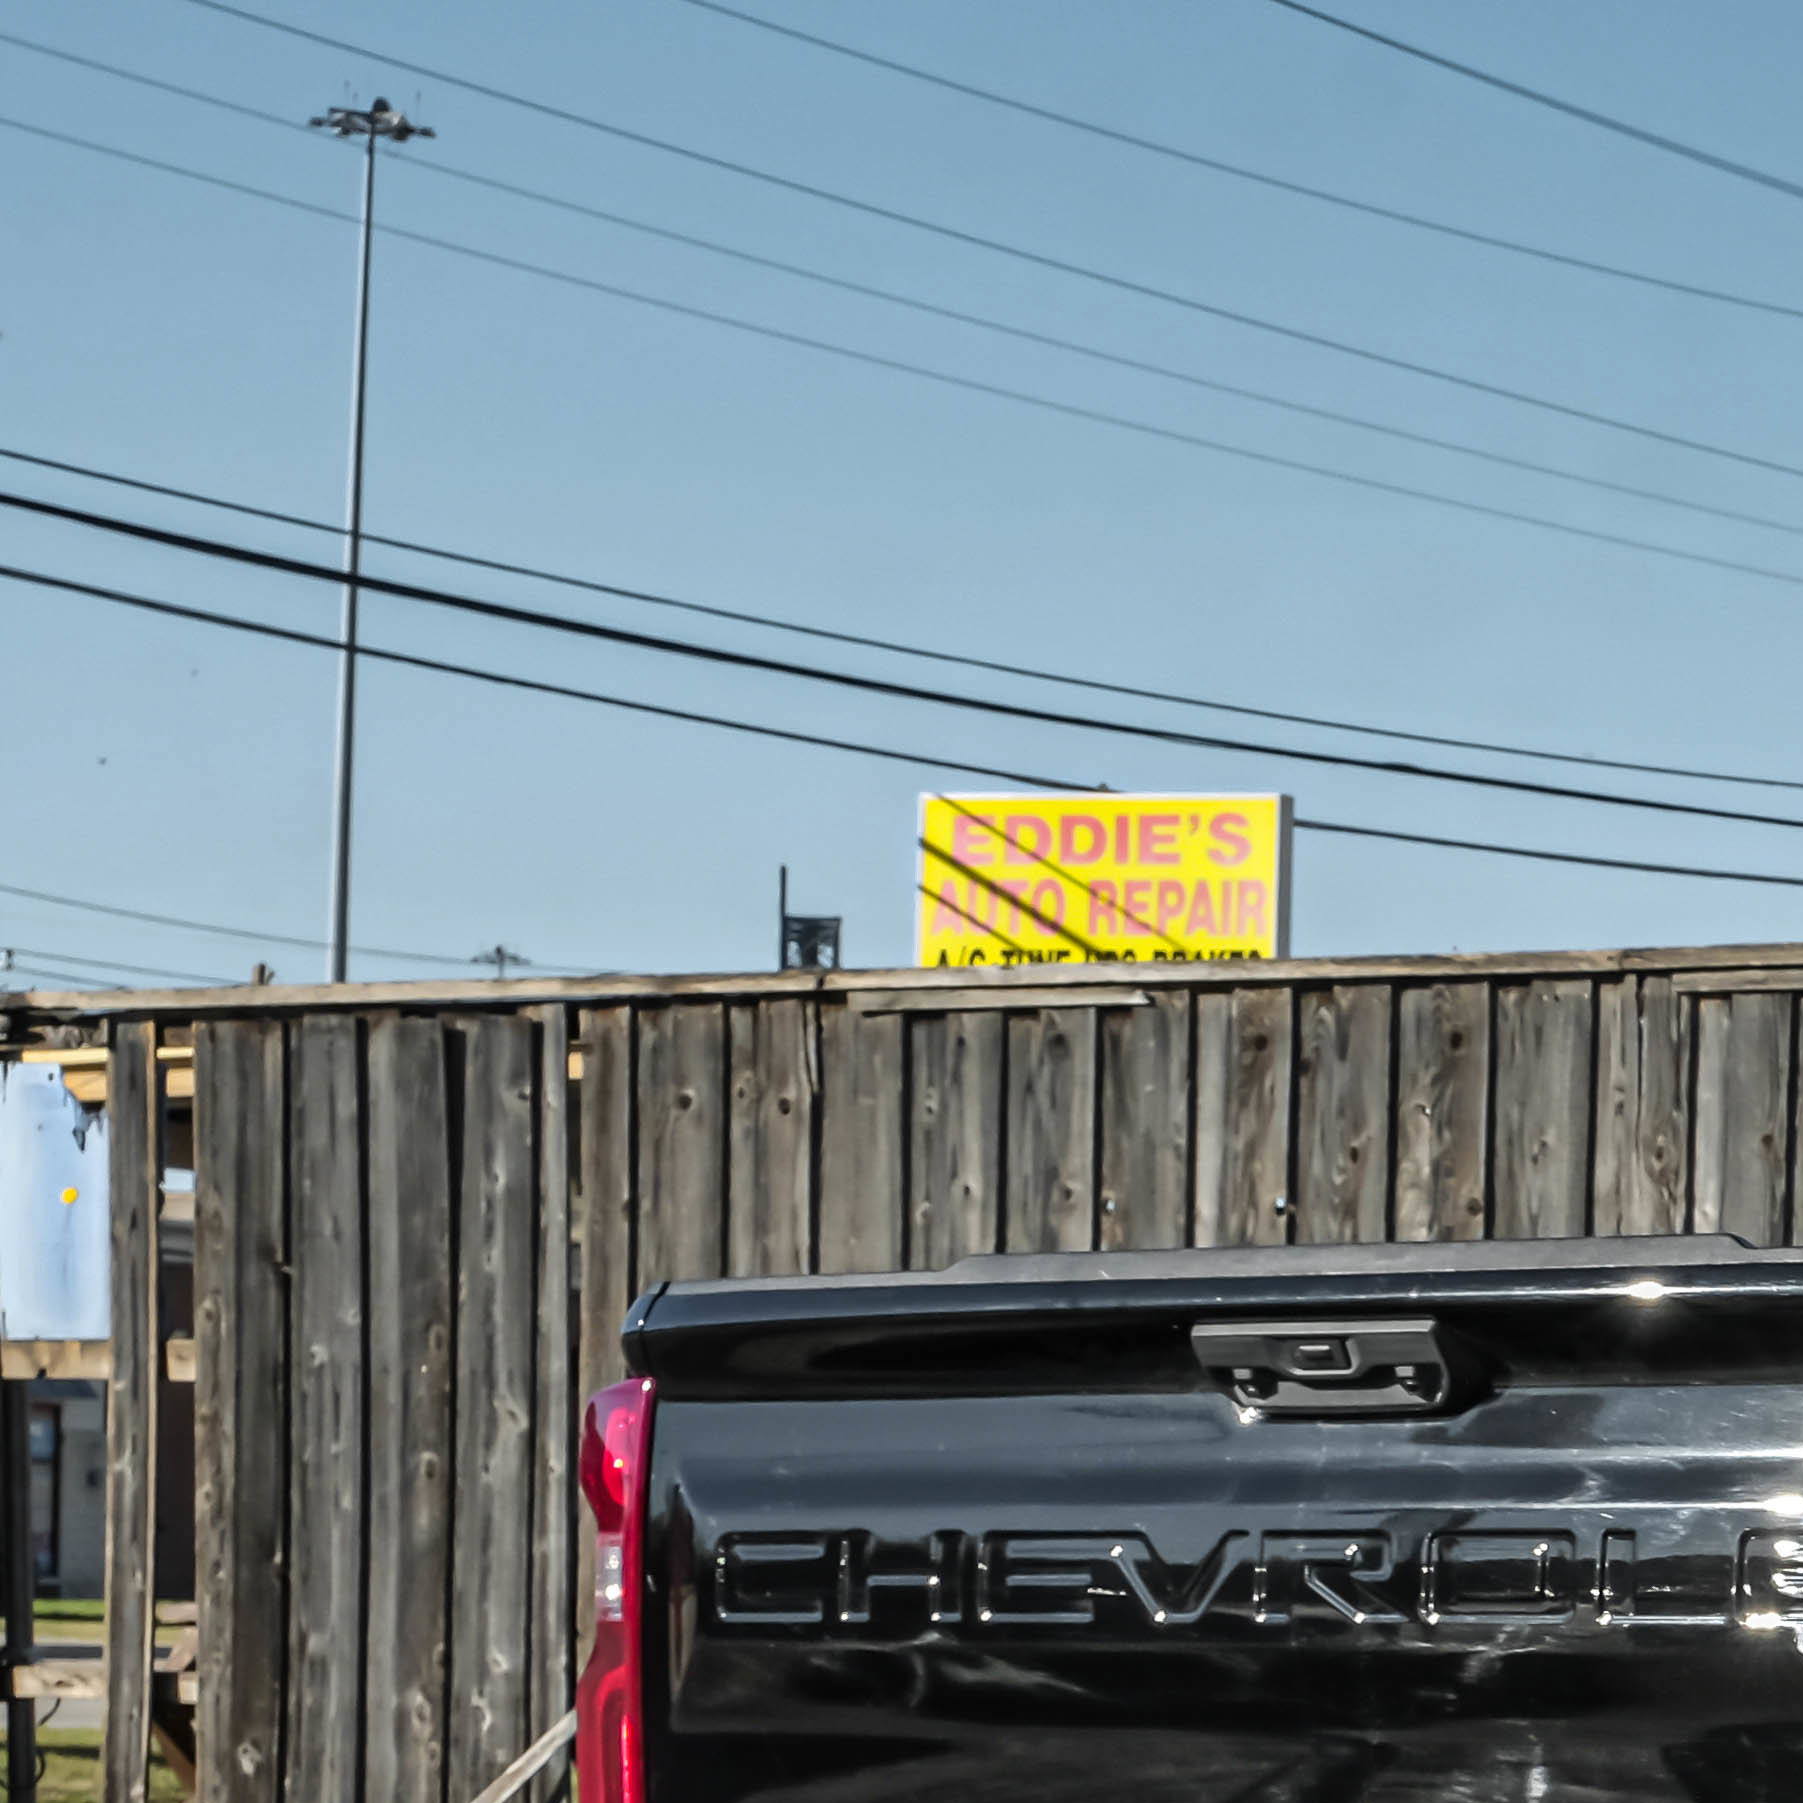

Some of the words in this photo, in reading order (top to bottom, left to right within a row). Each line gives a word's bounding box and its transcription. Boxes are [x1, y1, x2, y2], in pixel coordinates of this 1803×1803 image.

[951, 813, 1252, 866] EDDIE'S
[931, 878, 1066, 937] AUTO
[1088, 878, 1267, 937] REPAIR
